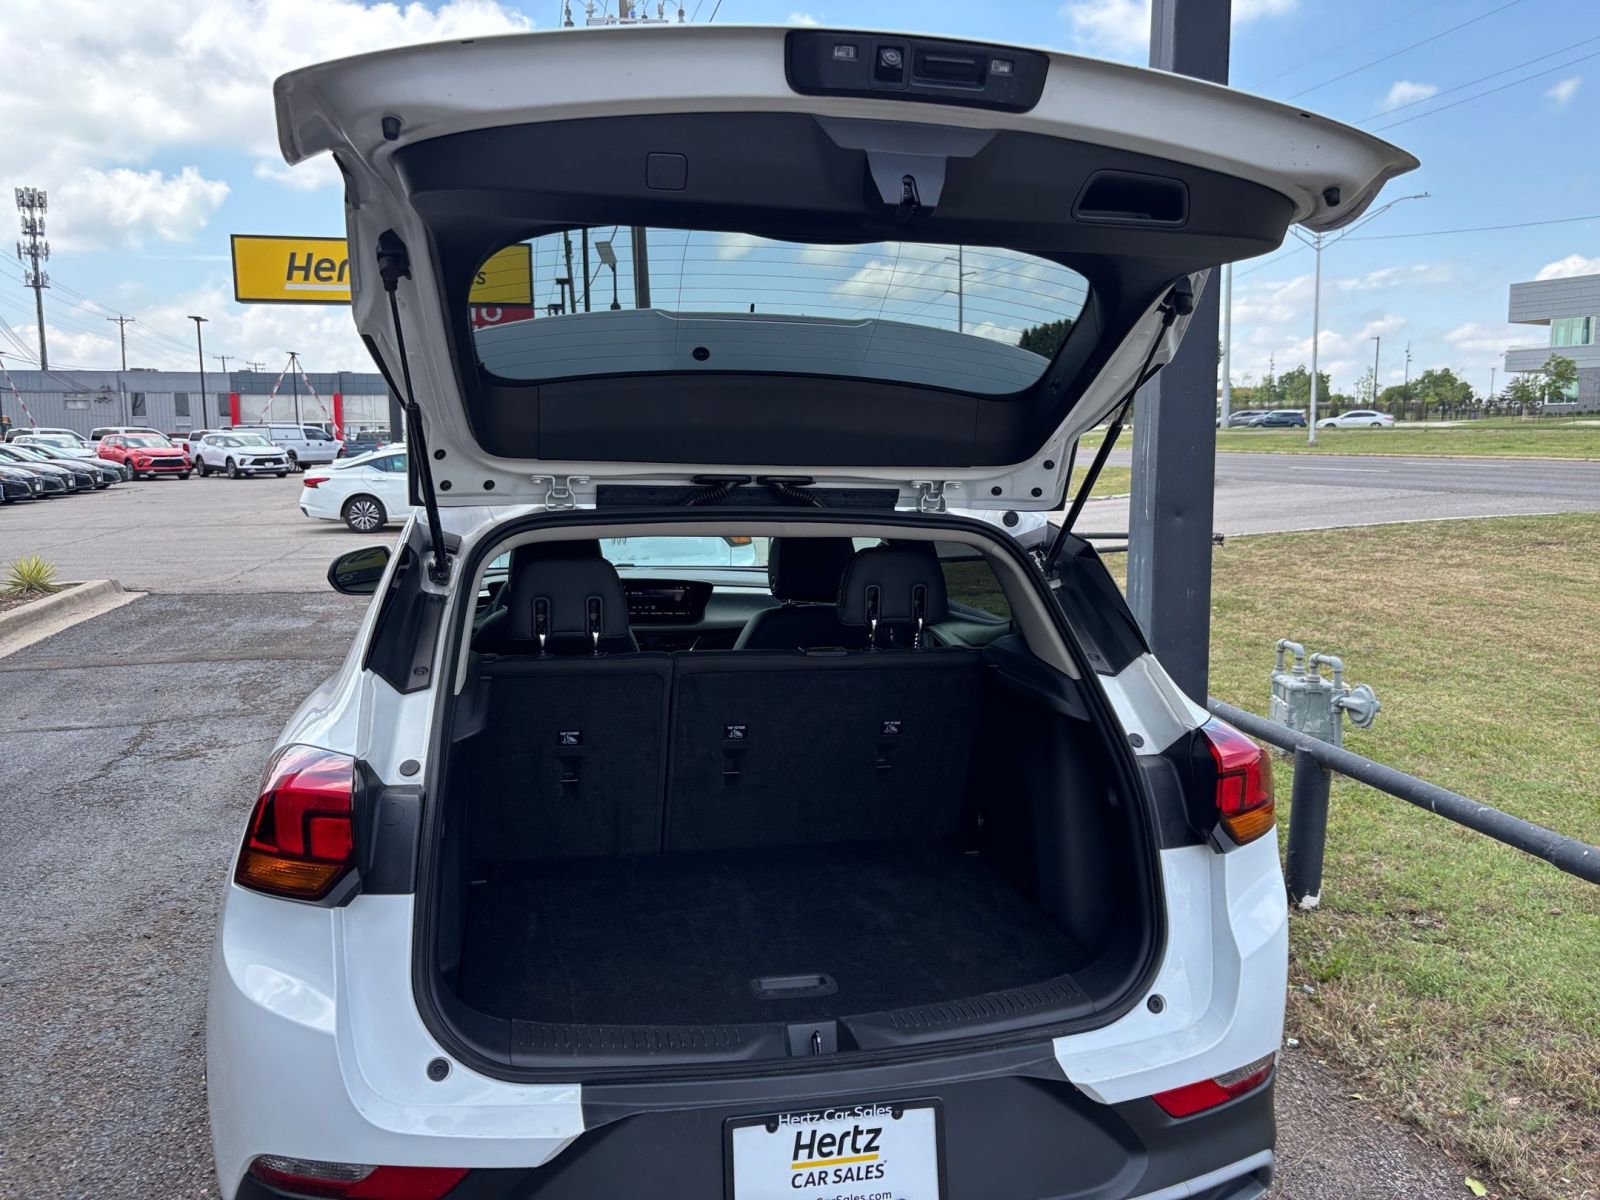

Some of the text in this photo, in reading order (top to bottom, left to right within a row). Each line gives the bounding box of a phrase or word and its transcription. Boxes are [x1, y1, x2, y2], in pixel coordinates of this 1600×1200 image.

[778, 1104, 893, 1126] Hertz Car Sales
[792, 1125, 883, 1161] Hertz
[791, 1163, 885, 1189] CAR SALES
[816, 1191, 892, 1200] Sales.com
